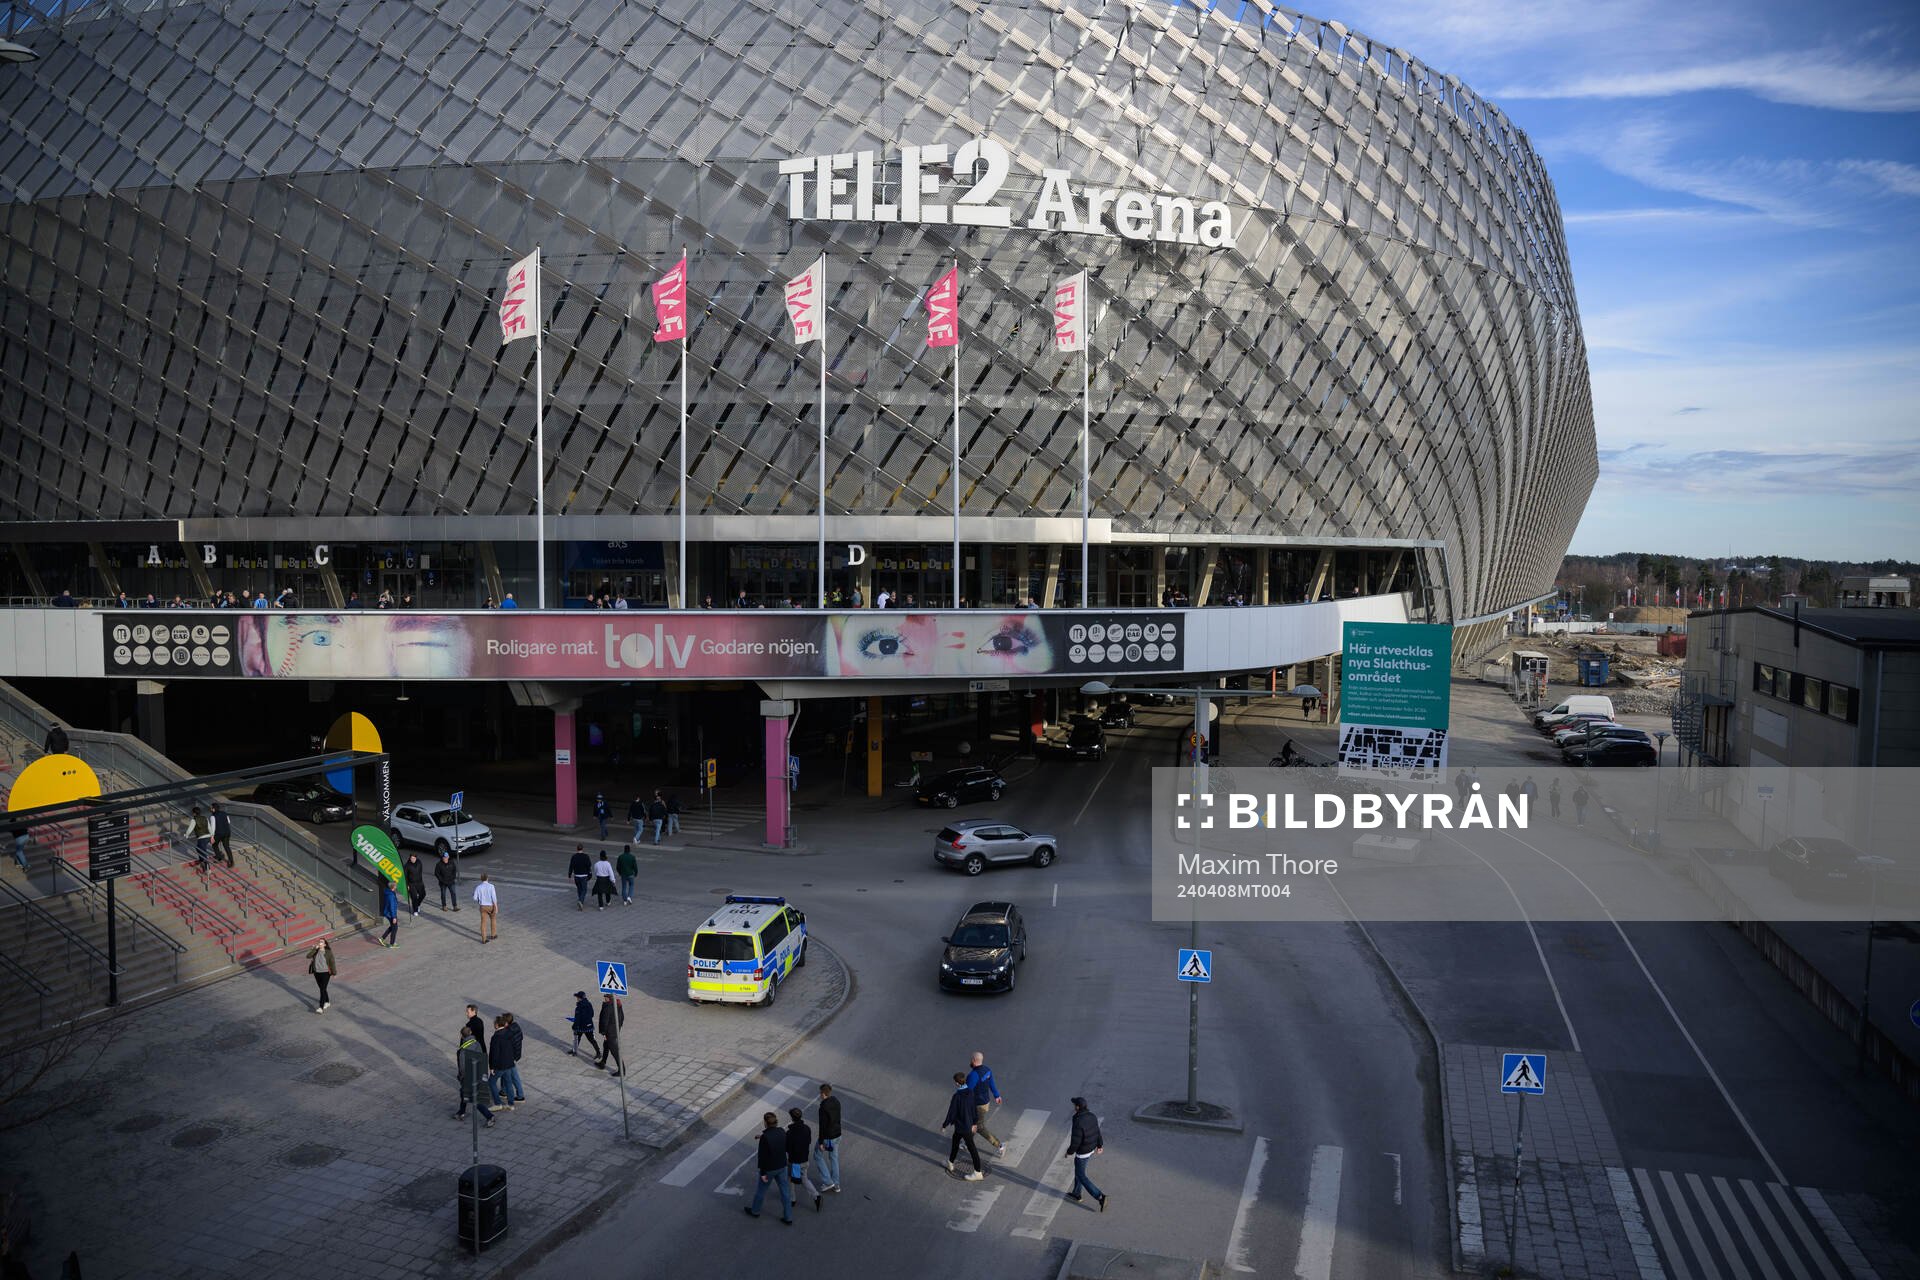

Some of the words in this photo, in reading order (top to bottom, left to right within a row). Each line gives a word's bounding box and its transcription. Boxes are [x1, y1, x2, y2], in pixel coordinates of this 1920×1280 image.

[778, 138, 1010, 229] TELE2
[1028, 168, 1237, 248] Arena
[147, 545, 161, 564] A
[203, 545, 217, 564] B
[315, 545, 329, 565] C
[847, 544, 866, 566] D
[486, 639, 556, 658] Roligare
[561, 640, 598, 655] mat.
[604, 623, 696, 669] tolv
[700, 638, 764, 655] Godare
[768, 638, 819, 658] nöjen.
[1349, 643, 1372, 654] Här
[1374, 645, 1433, 657] utvecklas
[1348, 659, 1371, 670] nya
[1373, 658, 1431, 671] Slakthus-
[1348, 671, 1401, 683] området
[693, 959, 717, 968] POLIS
